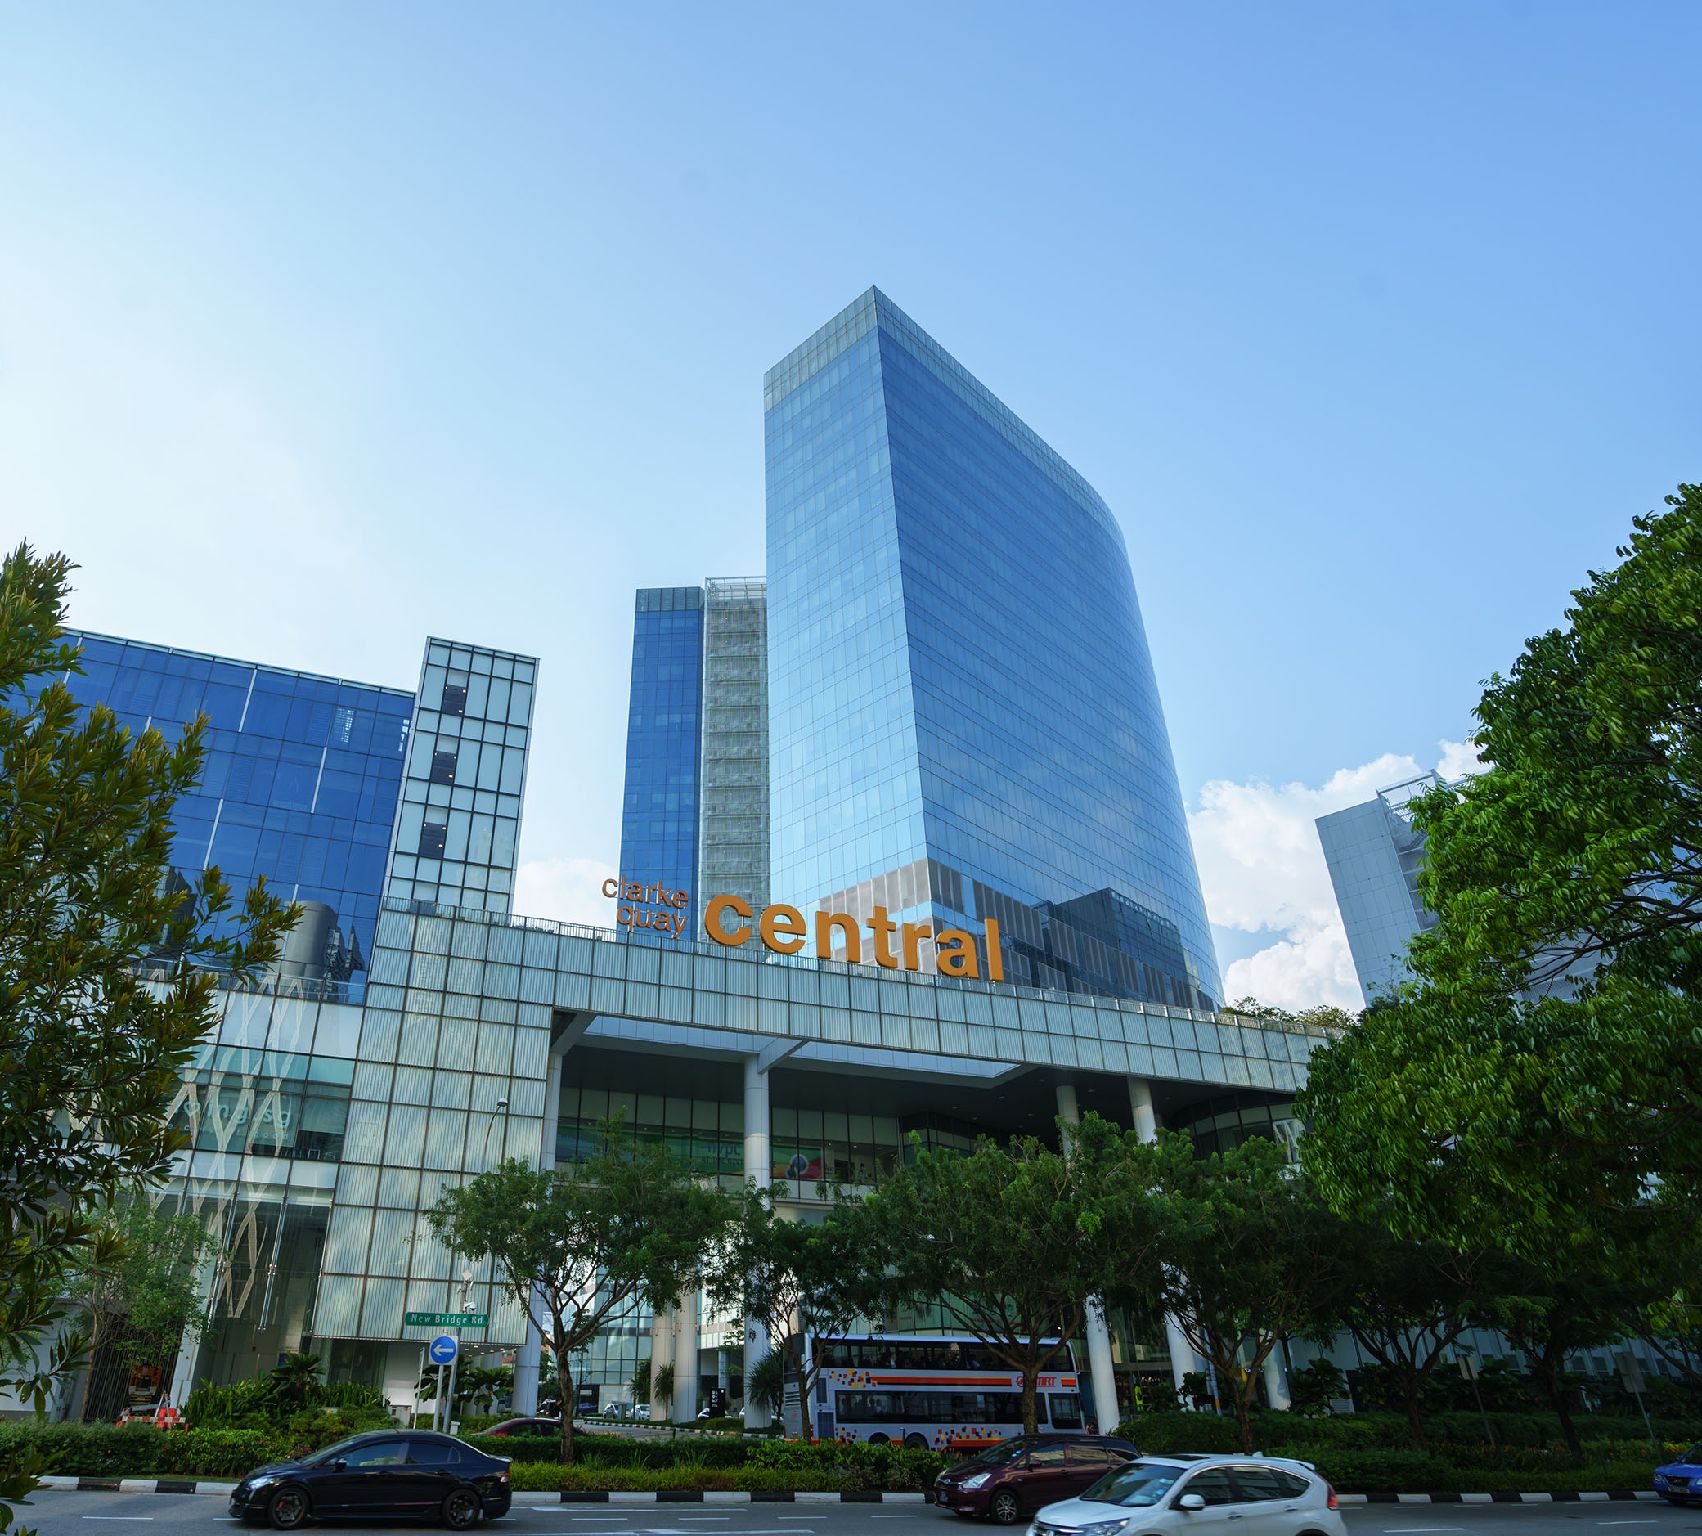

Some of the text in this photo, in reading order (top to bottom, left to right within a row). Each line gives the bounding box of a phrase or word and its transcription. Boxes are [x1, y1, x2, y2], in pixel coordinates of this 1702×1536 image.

[602, 874, 689, 909] clarke
[617, 904, 689, 939] quay
[704, 894, 1004, 982] central
[410, 1313, 484, 1326] New Bridge Rd
